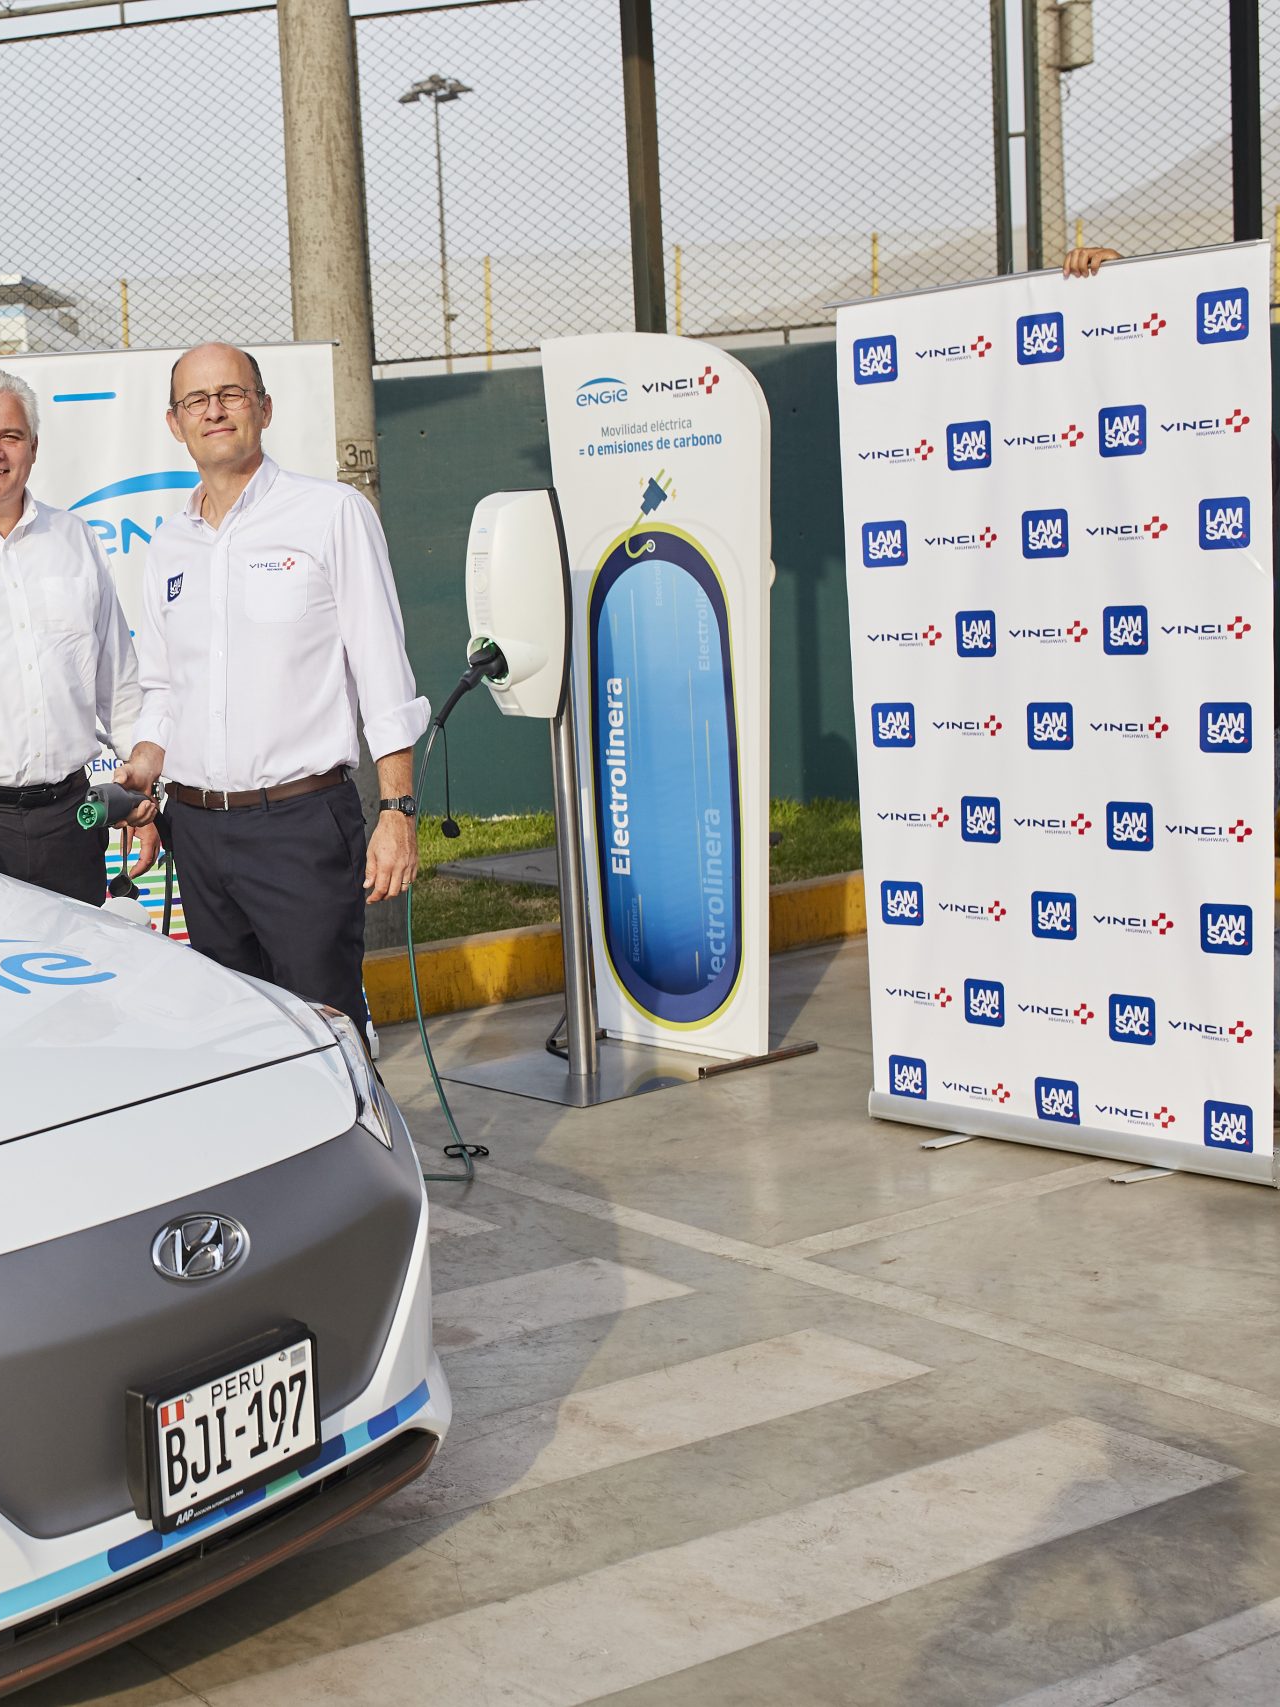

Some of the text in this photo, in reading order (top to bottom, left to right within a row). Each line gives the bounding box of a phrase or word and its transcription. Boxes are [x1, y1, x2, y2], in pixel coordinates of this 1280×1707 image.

[1203, 298, 1242, 320] LAM
[1023, 321, 1058, 342] LAM
[1081, 323, 1137, 338] VINCI
[859, 344, 892, 364] LAM
[915, 345, 966, 359] VINCI
[641, 377, 694, 393] VINCI
[601, 417, 692, 438] Movilidad eléctrica
[1104, 414, 1140, 435] LAM
[1160, 418, 1220, 433] VINCI
[587, 444, 595, 457] 0
[597, 440, 654, 456] emisiones
[656, 437, 671, 450] de
[673, 433, 723, 449] carbono
[952, 429, 986, 449] LAM
[1003, 433, 1056, 447] VINCI
[344, 442, 374, 467] 3m
[858, 448, 910, 460] VINCI
[1205, 507, 1243, 527] LAM
[1028, 518, 1062, 537] LAM
[1085, 524, 1138, 536] VINCI
[868, 529, 902, 547] LAM
[924, 534, 976, 546] VINCI
[961, 619, 991, 636] LAM
[1109, 615, 1142, 633] LAM
[1160, 624, 1222, 635] VINCI
[867, 632, 918, 642] VINCI
[1008, 628, 1062, 638] VINCI
[877, 711, 910, 728] LAM
[932, 721, 980, 730] VINCI
[1033, 711, 1067, 728] LAM
[1089, 722, 1144, 732] VINCI
[1207, 712, 1245, 730] LAM
[606, 677, 631, 876] Electrolinera
[876, 812, 927, 822] VINCI
[966, 805, 996, 822] LAM
[1113, 811, 1147, 829] LAM
[1013, 818, 1066, 829] VINCI
[1165, 824, 1223, 836] VINCI
[886, 889, 918, 906] LAM
[938, 902, 984, 915] VINCI
[1037, 900, 1071, 918] LAM
[1092, 915, 1147, 928] VINCI
[1207, 913, 1246, 932] LAM
[885, 988, 931, 1000] VINCI
[969, 987, 999, 1006] LAM
[1017, 1004, 1069, 1017] VINCI
[1115, 1003, 1149, 1023] LAM
[1168, 1020, 1223, 1035] VINCI
[894, 1063, 922, 1082] LAM
[942, 1081, 988, 1096] VINCI
[1040, 1086, 1073, 1105] LAM
[1095, 1104, 1149, 1120] VINCI
[1211, 1110, 1247, 1132] LAM
[211, 1363, 265, 1406] PERU
[165, 1370, 307, 1498] BJI-197
[176, 1509, 194, 1526] AAP
